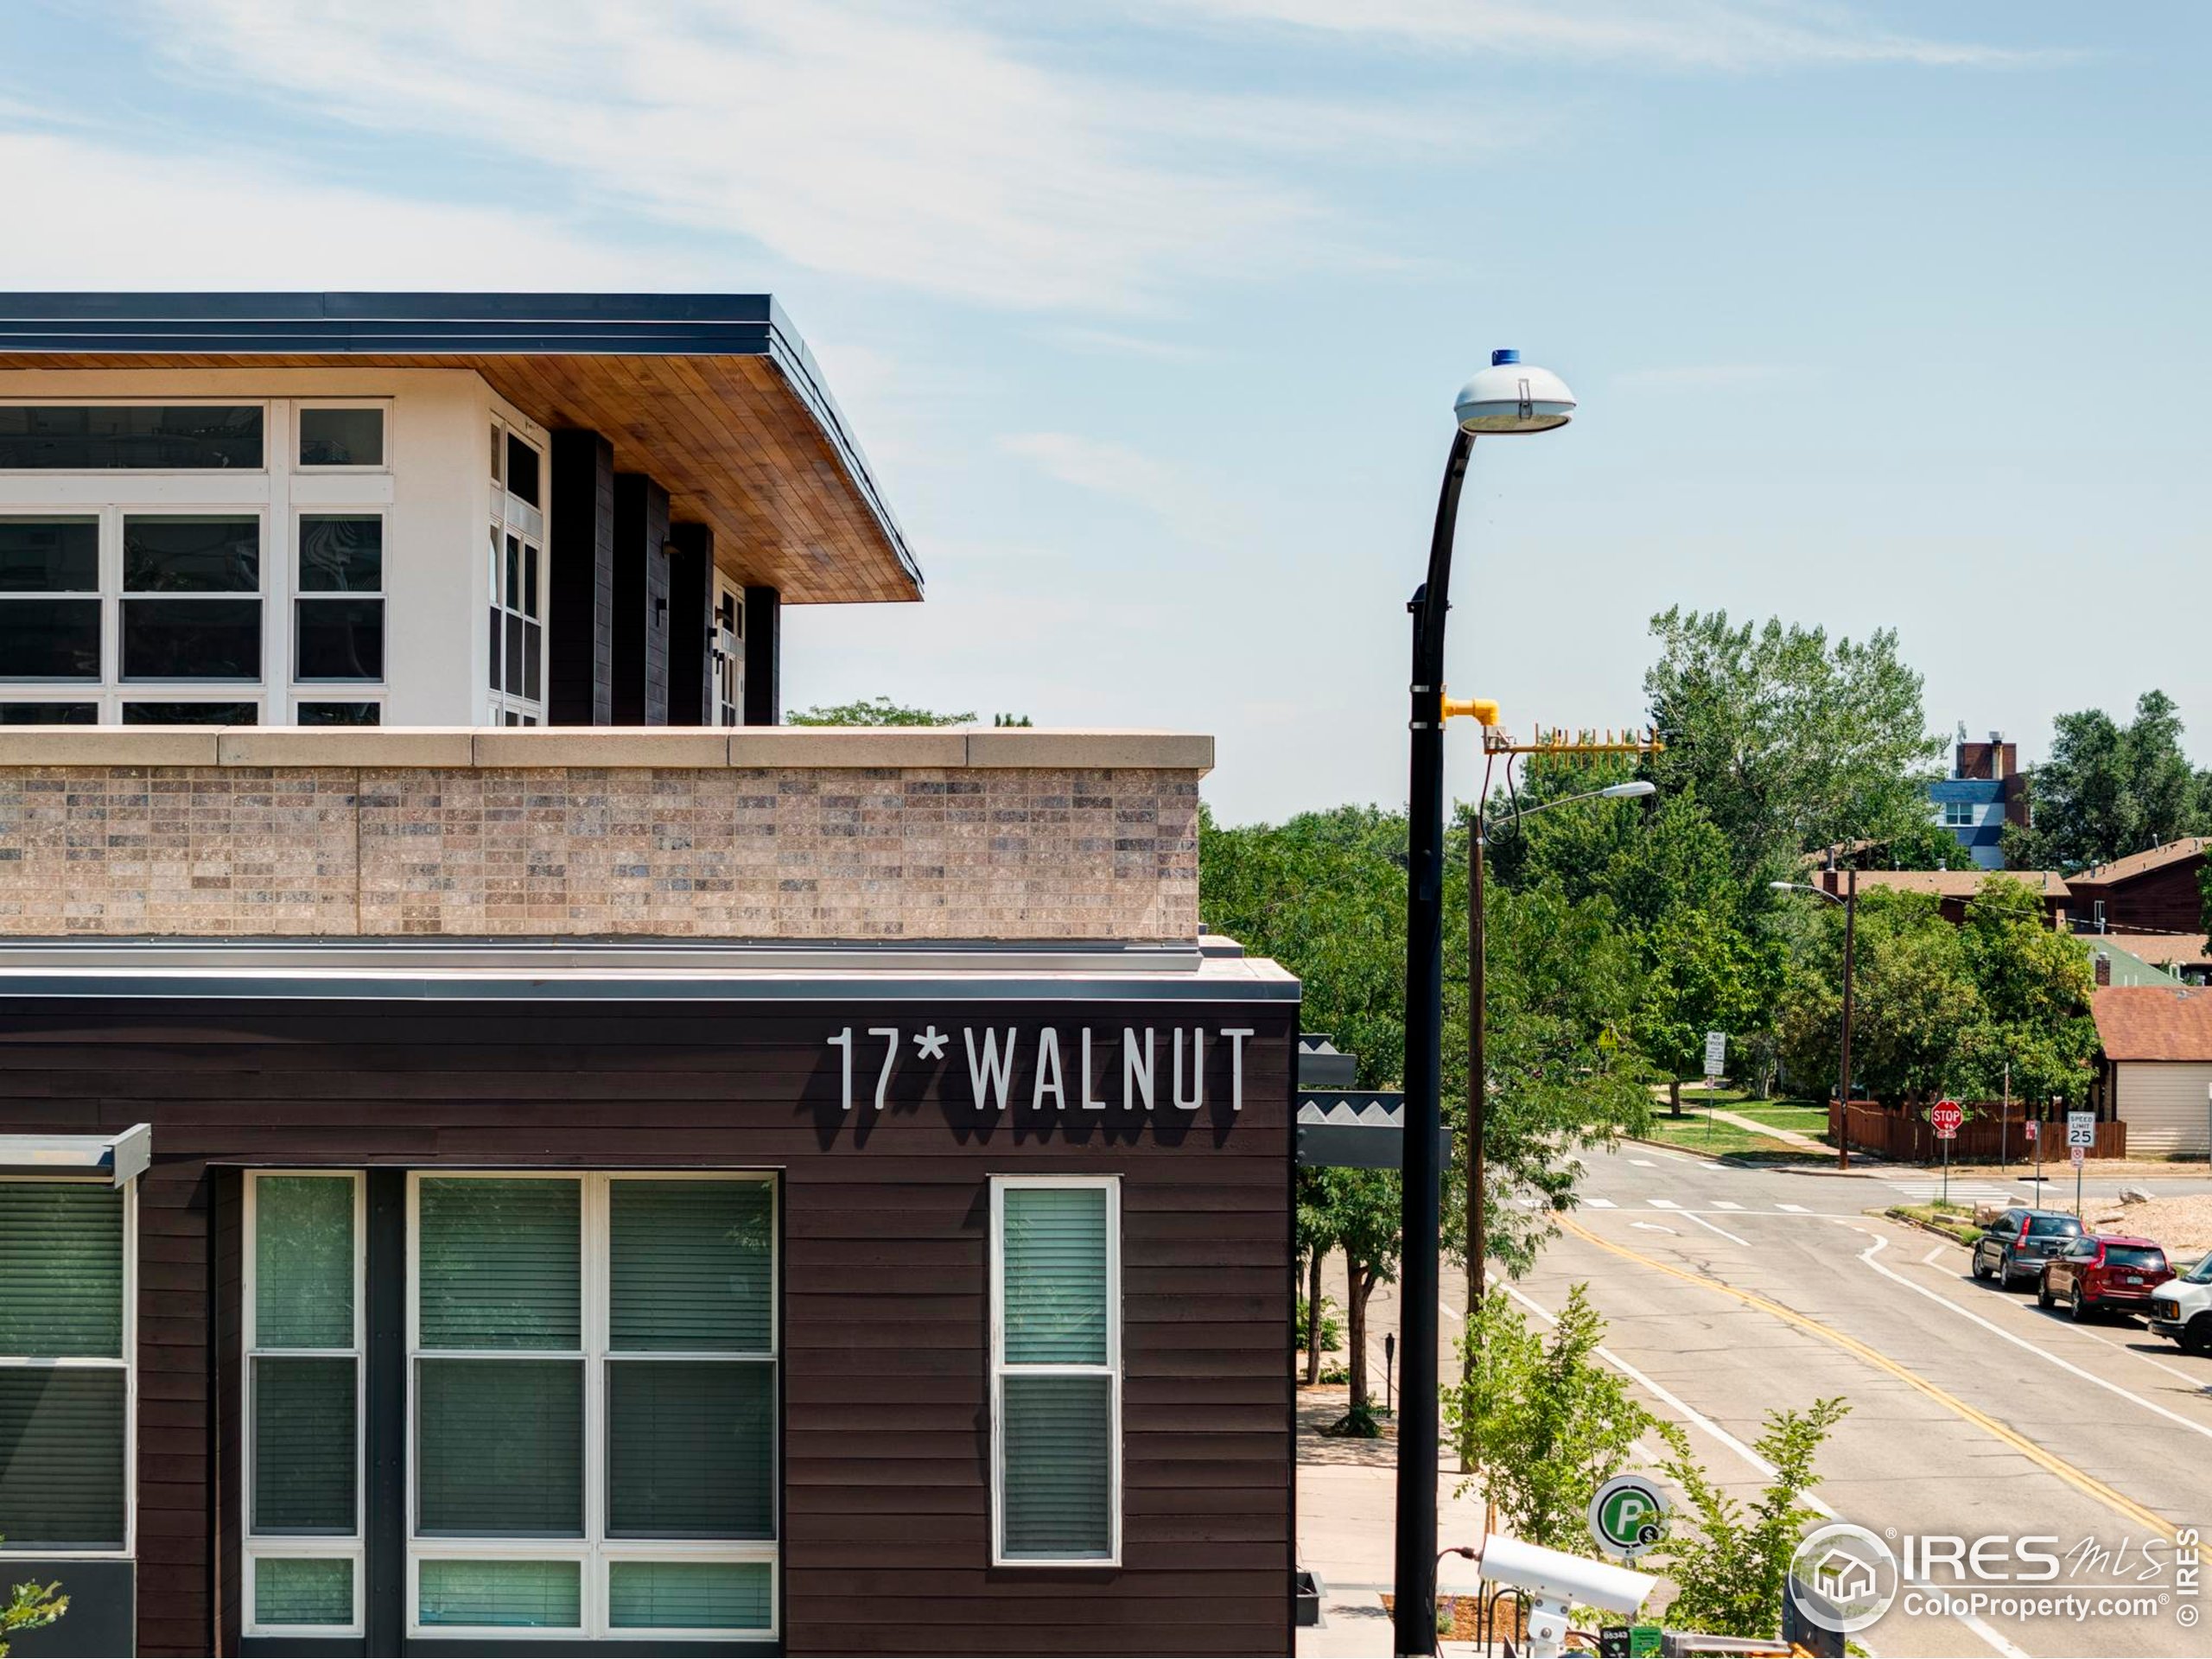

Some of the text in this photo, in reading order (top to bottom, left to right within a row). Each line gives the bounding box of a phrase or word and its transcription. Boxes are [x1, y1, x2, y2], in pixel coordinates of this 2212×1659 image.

[1934, 1110, 1961, 1122] STOP
[2070, 1130, 2092, 1142] 25
[1617, 1499, 1645, 1535] P
